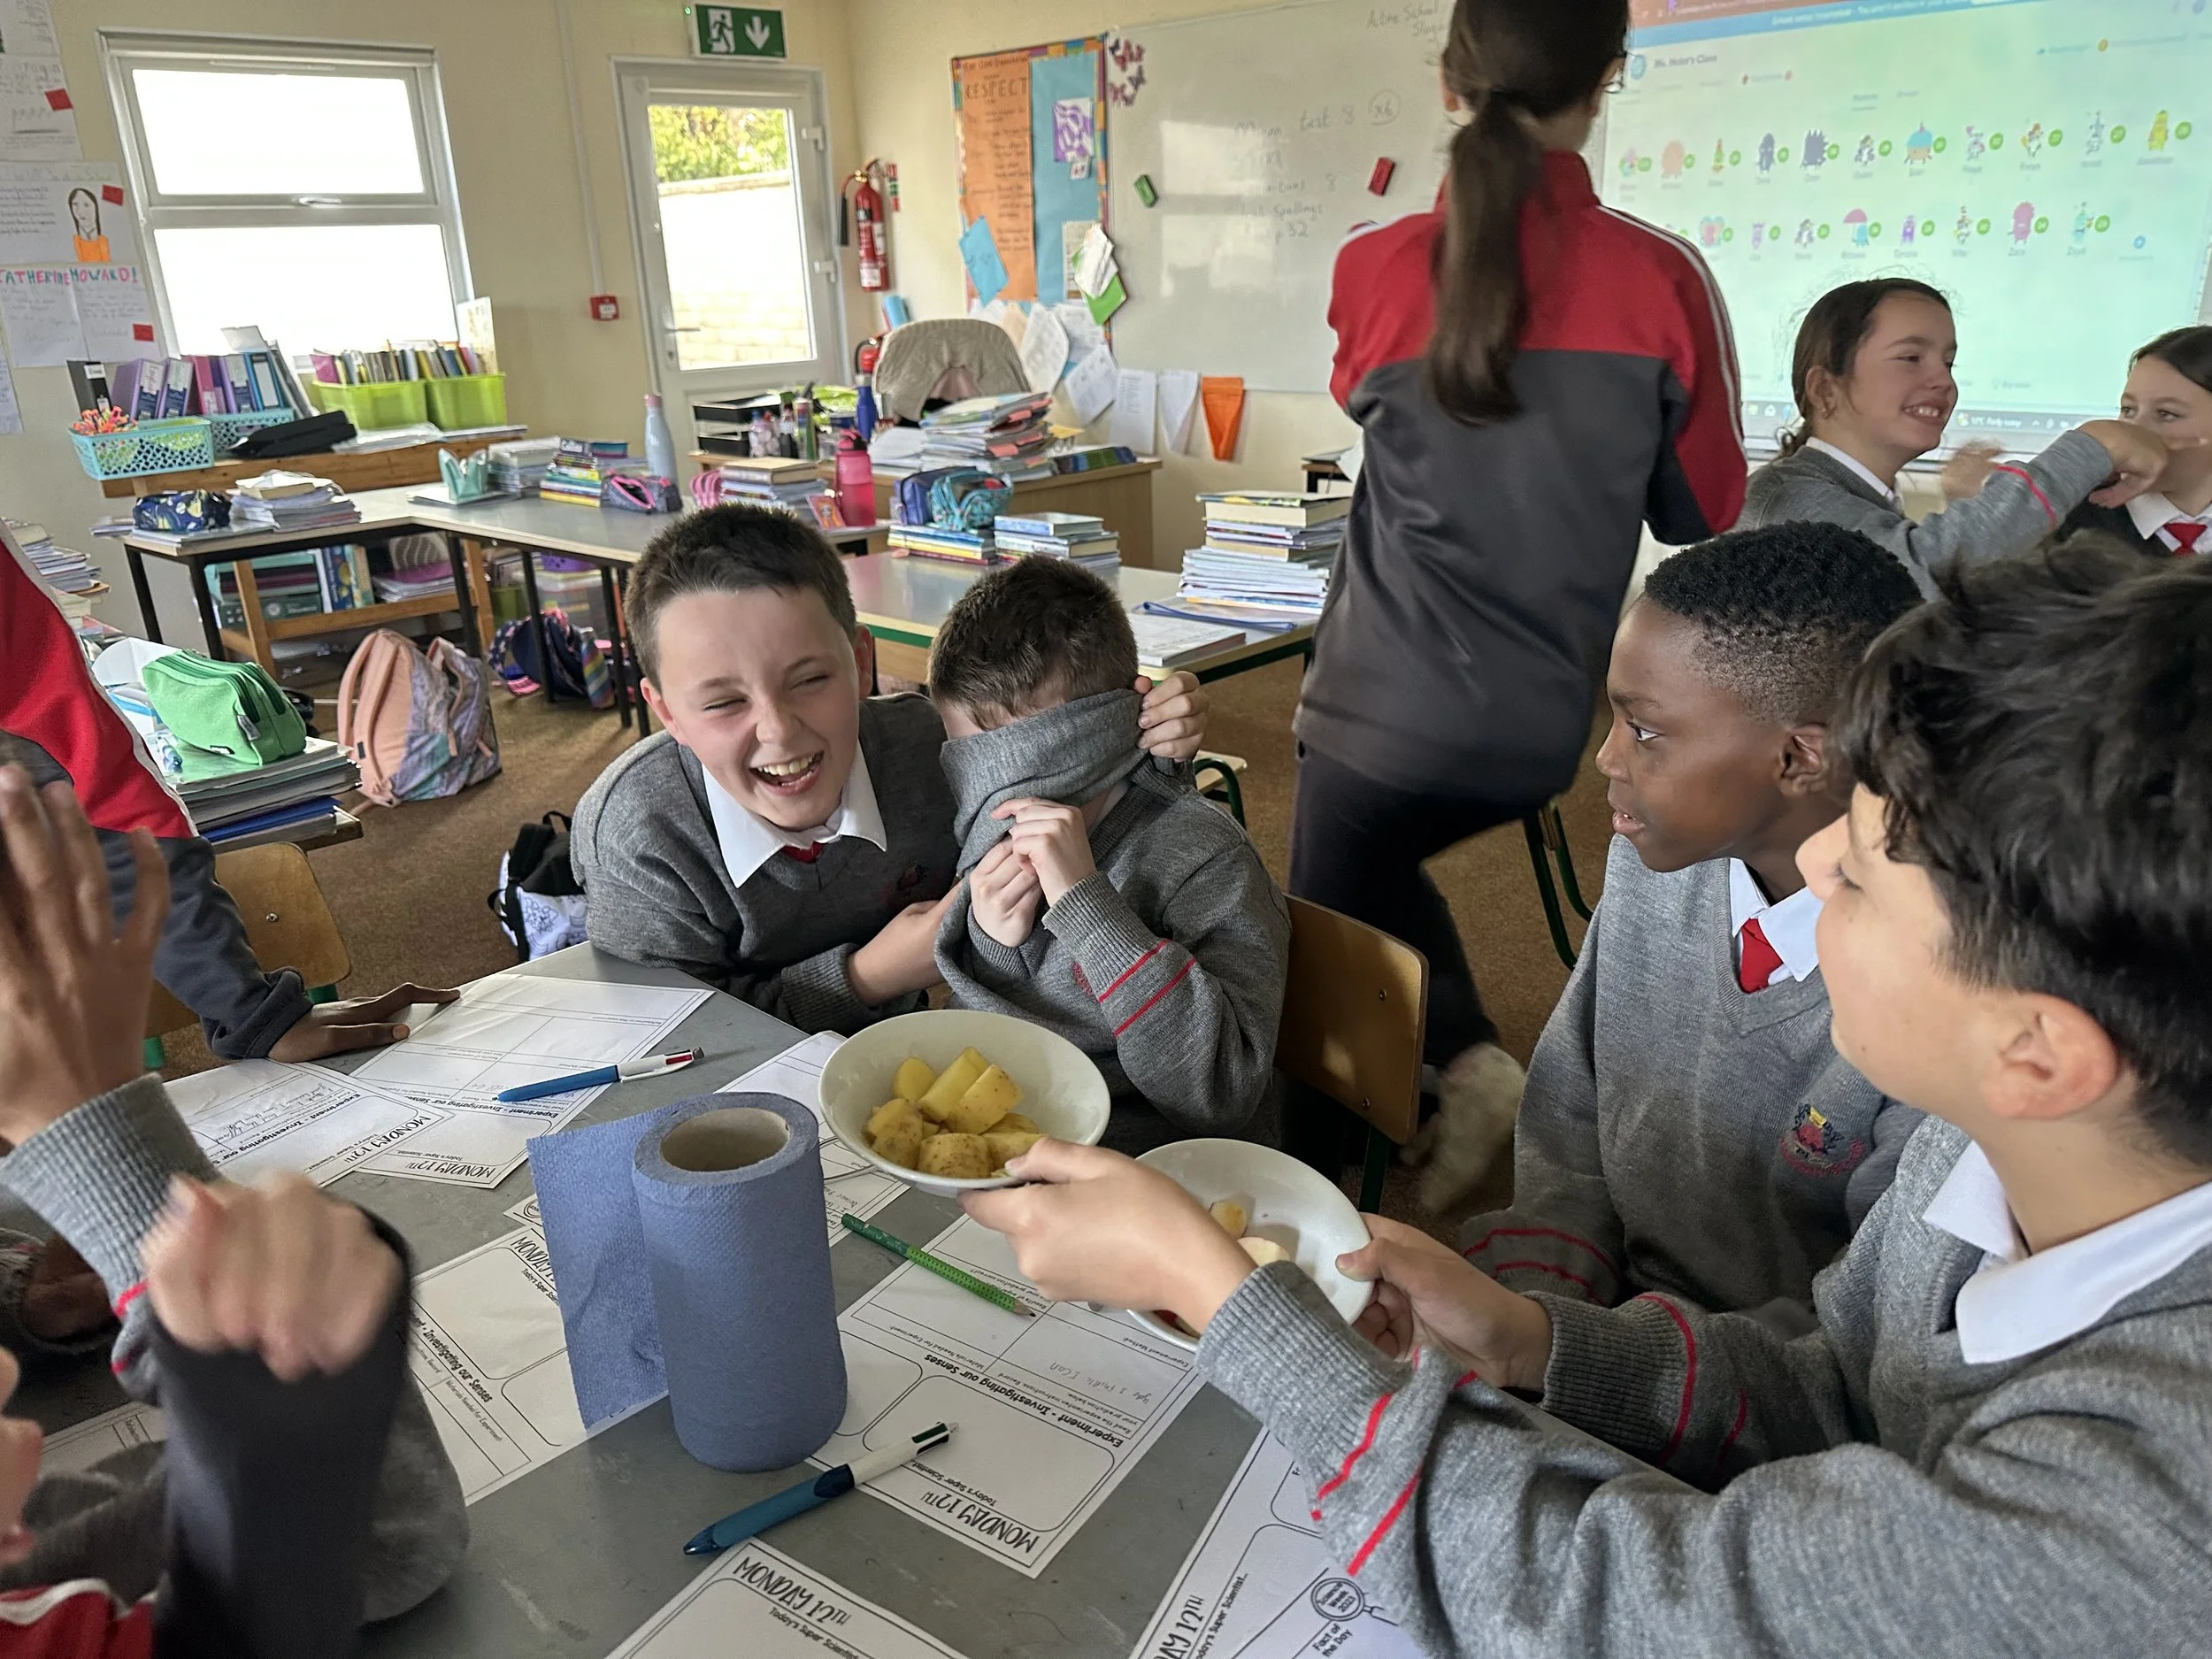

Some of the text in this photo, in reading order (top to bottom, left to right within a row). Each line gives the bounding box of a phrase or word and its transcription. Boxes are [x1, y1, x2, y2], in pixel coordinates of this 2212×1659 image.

[965, 77, 1028, 99] RESPECT
[70, 267, 138, 283] HOWARD!
[310, 1093, 361, 1120] Experiment
[404, 1095, 431, 1104] Sense
[447, 1100, 503, 1113] Investigating
[509, 1108, 559, 1118] Experiment
[240, 1120, 304, 1152] Investigating
[343, 1115, 431, 1164] MONDAY 12TH
[222, 1149, 240, 1160] our
[406, 1161, 496, 1179] MONDAY 12TH
[423, 1329, 464, 1371] Investigating
[458, 1367, 473, 1381] our
[469, 1379, 493, 1403] Senses
[925, 1354, 960, 1374] Senses
[959, 1370, 979, 1382] our
[979, 1379, 1052, 1416] Investigating
[1057, 1414, 1124, 1448] Experiment
[1117, 1425, 1132, 1434] Read
[943, 1477, 967, 1494] Super
[966, 1486, 997, 1507] Today's
[921, 1490, 1040, 1554] MONDAY 12TH
[733, 1556, 853, 1626] MONDAY 12TH
[1317, 1582, 1343, 1606] Science
[1328, 1590, 1349, 1608] Week
[770, 1607, 799, 1629] Today's
[799, 1624, 824, 1643] Super
[1175, 1595, 1204, 1632] 12TH
[1209, 1609, 1227, 1634] Super
[1312, 1624, 1341, 1652] Fact of
[1322, 1629, 1354, 1658] the Day
